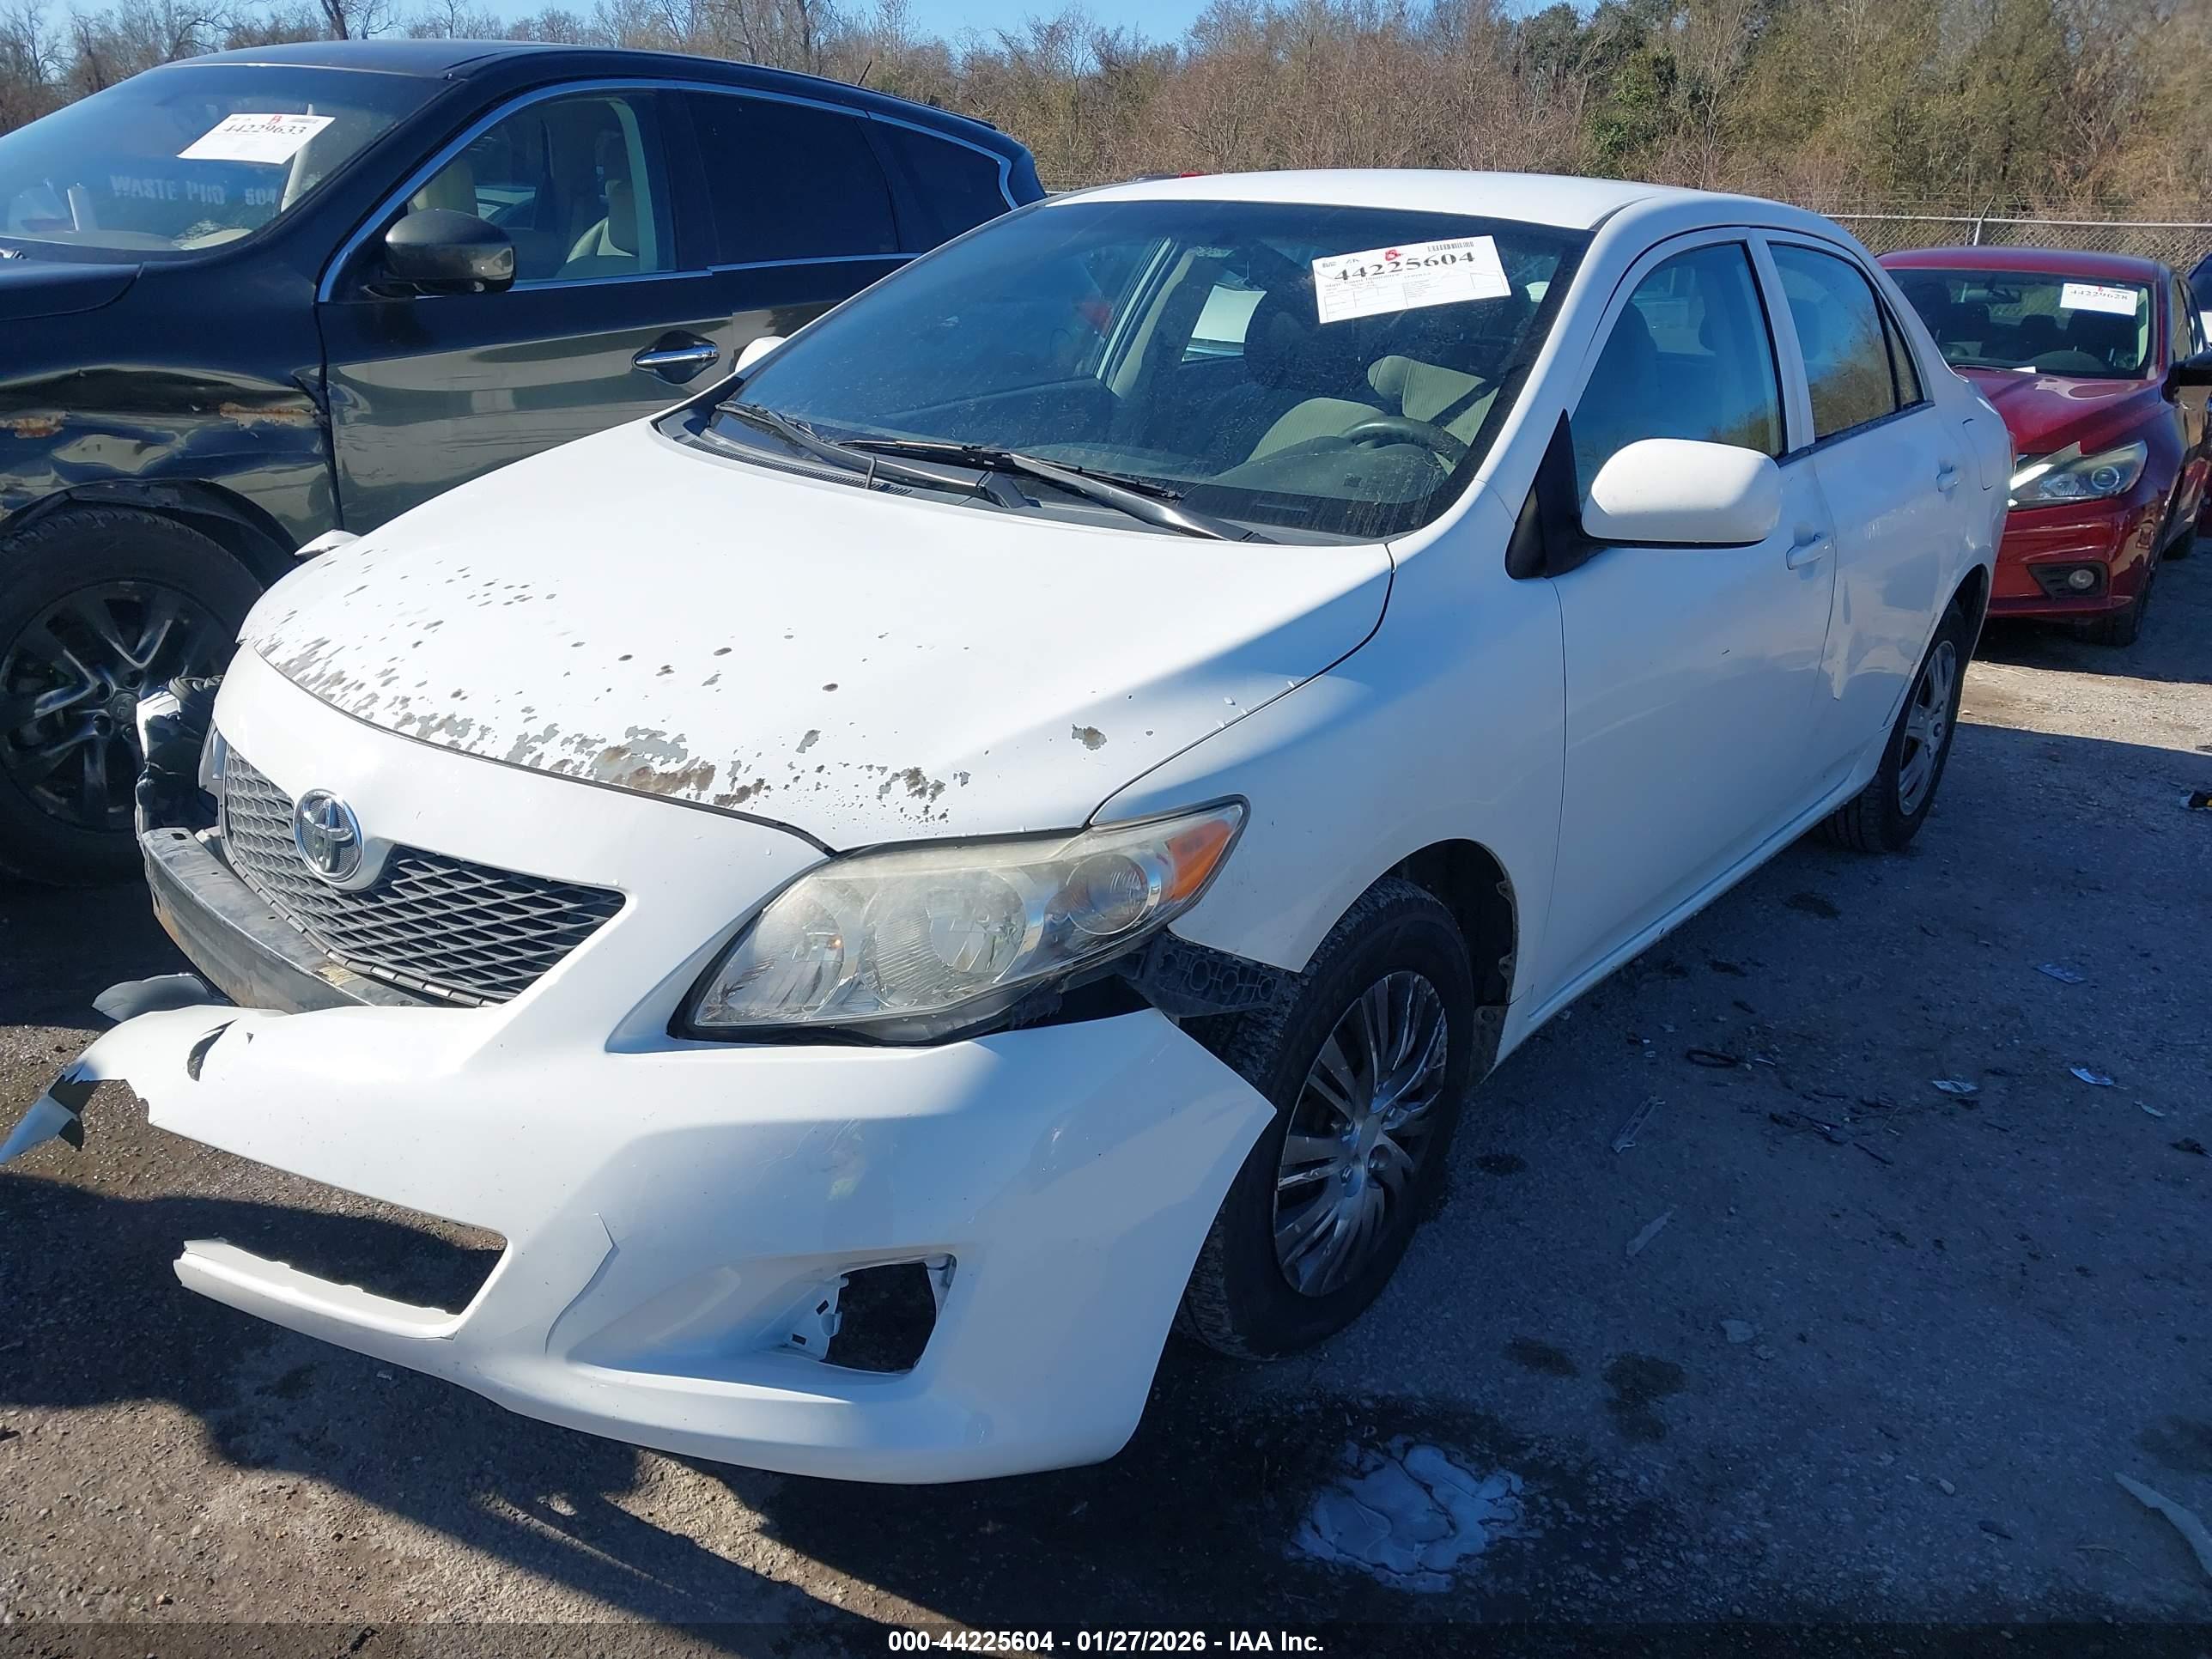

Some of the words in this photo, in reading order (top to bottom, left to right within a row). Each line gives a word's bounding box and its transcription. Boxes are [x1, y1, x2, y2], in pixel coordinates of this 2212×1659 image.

[222, 124, 307, 136] 44229633
[110, 175, 177, 200] WASTE
[1334, 252, 1475, 281] 44225604
